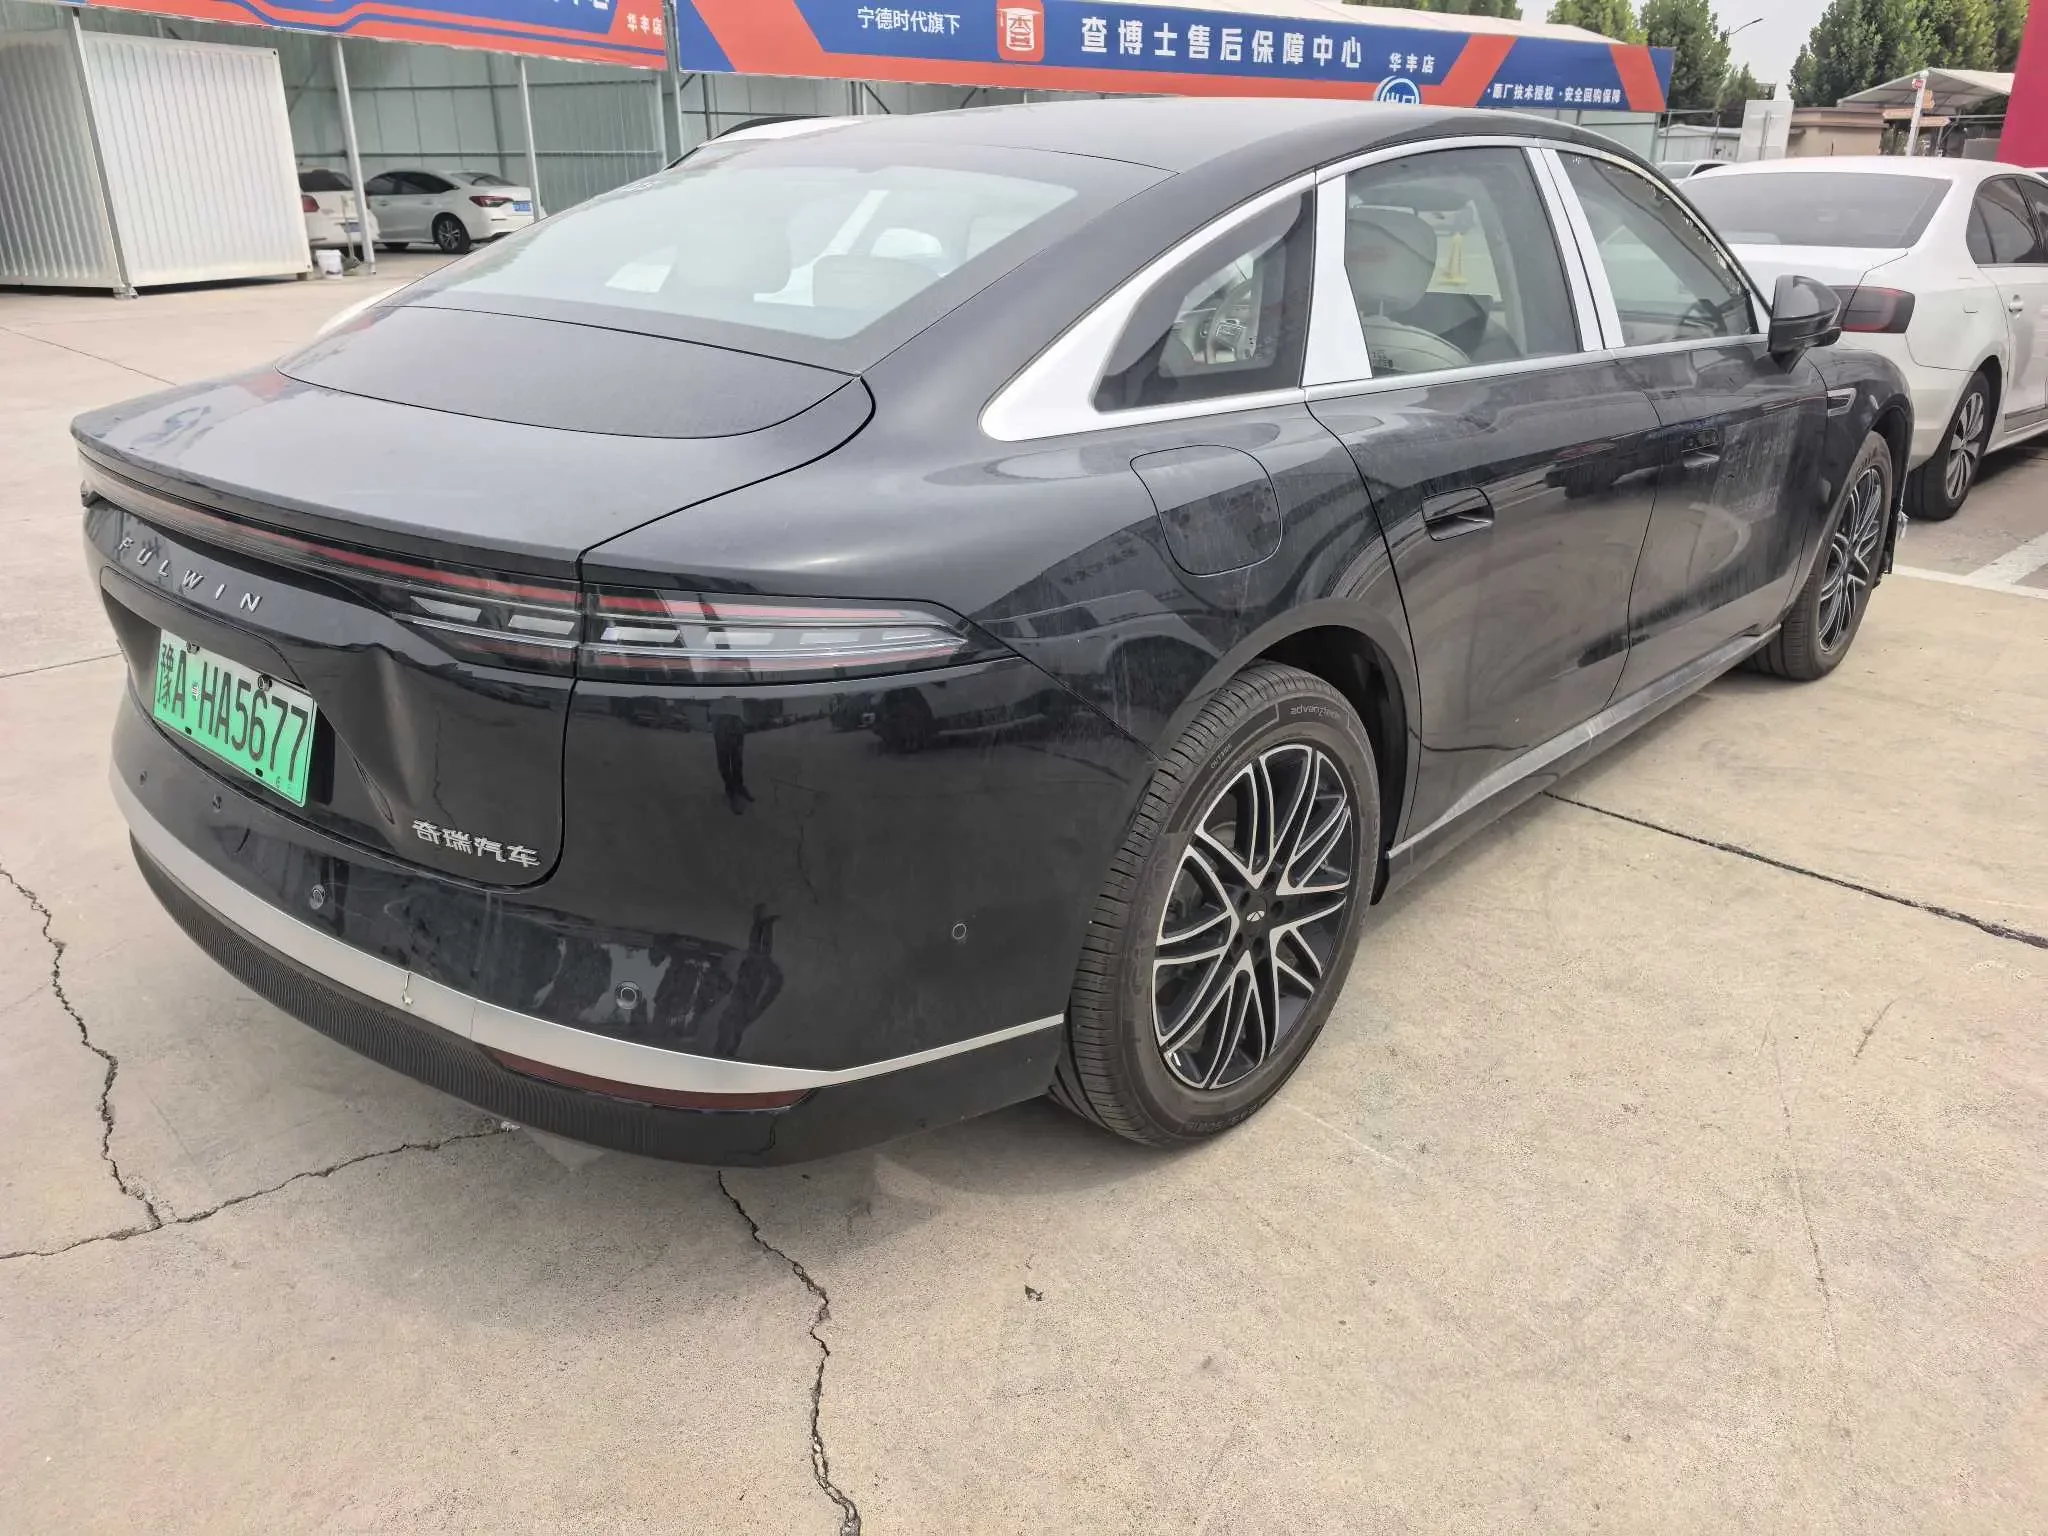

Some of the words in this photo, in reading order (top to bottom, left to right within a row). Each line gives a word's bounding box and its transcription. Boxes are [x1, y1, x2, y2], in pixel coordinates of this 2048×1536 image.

[857, 6, 960, 35] 宁德时代旗下
[1081, 16, 1362, 68] 查博士售后保障中心
[1389, 52, 1436, 73] 华丰店
[118, 537, 262, 613] FULWIN
[412, 819, 541, 868] 奇瑞汽车
